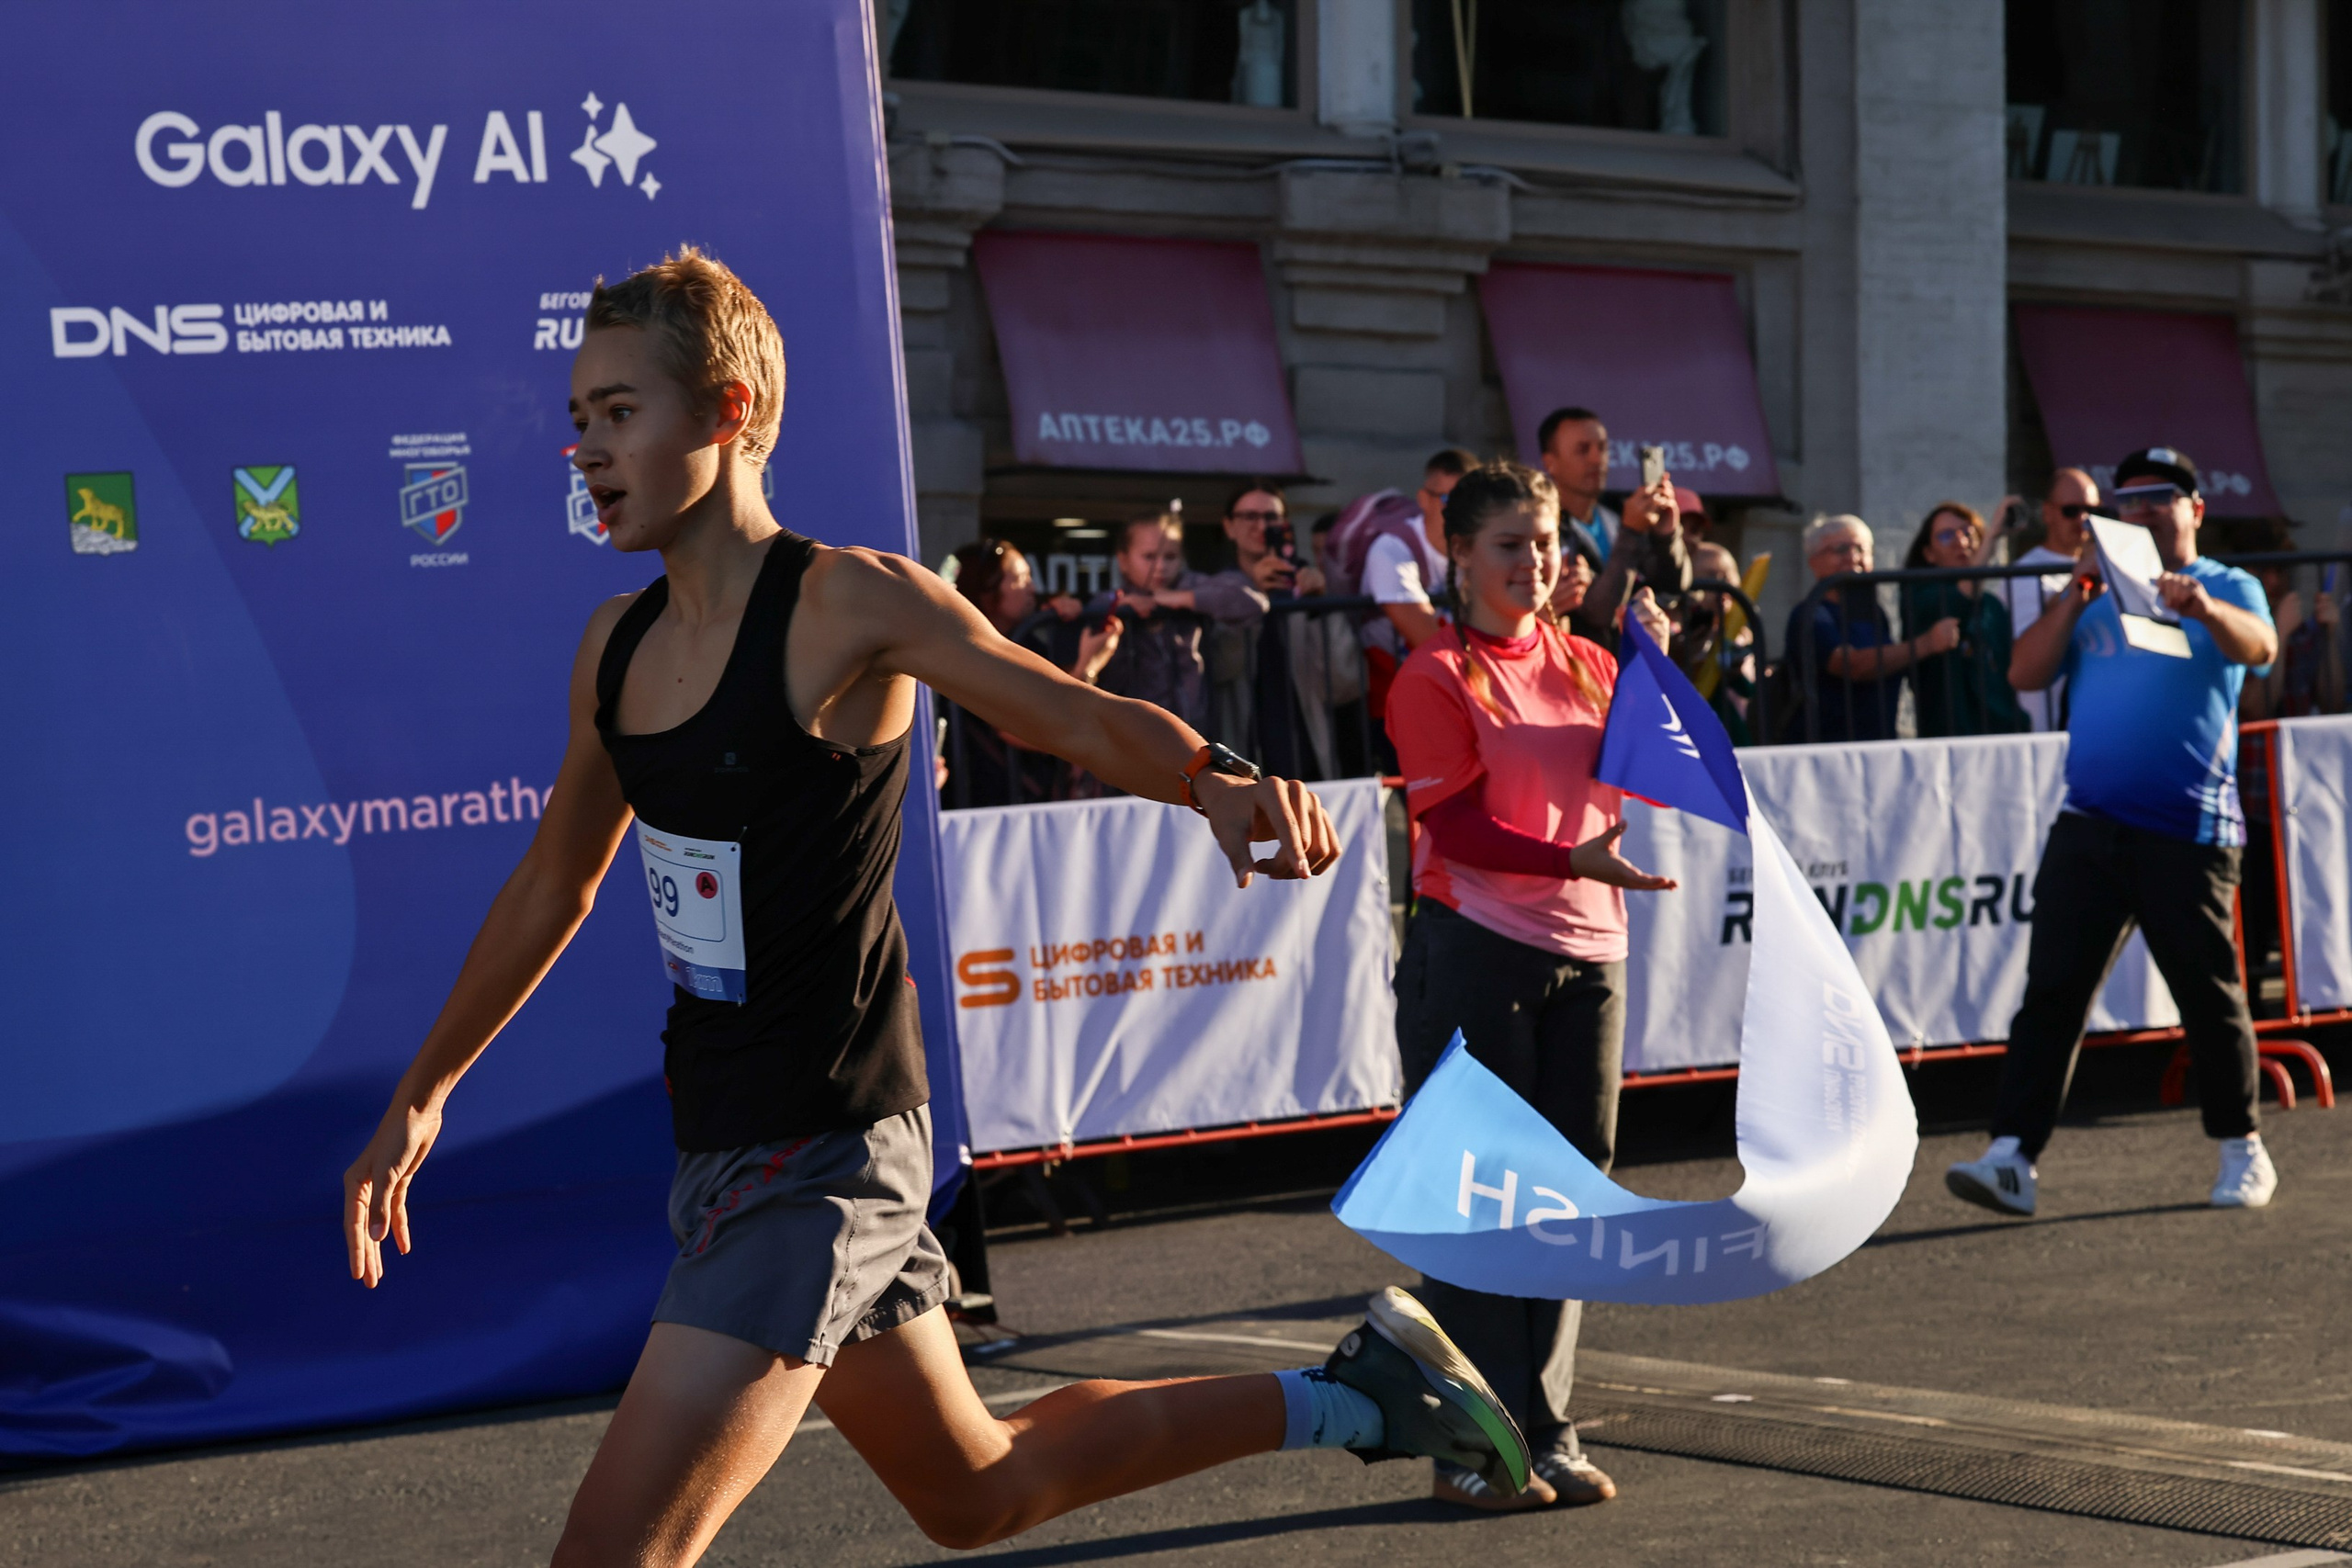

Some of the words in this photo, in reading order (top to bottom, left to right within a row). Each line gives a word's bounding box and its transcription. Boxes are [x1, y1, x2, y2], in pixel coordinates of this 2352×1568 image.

[135, 110, 448, 209] Galaxy
[473, 110, 548, 184] AI
[50, 304, 229, 357] DNS
[233, 300, 364, 327] ЦИФРОВАЯ
[369, 299, 388, 321] И
[236, 328, 344, 353] БЫТОВАЯ
[350, 325, 452, 349] ТЕХНИКА
[1039, 412, 1271, 448] АПТЕКА25.РФ
[410, 479, 459, 515] ГТО
[410, 553, 469, 568] РОССИИ
[1031, 933, 1177, 971] ЦИФРОВАЯ
[1185, 931, 1204, 954] И
[1033, 968, 1153, 1002] БЫТОВАЯ
[1161, 957, 1277, 989] ТЕХНИКА
